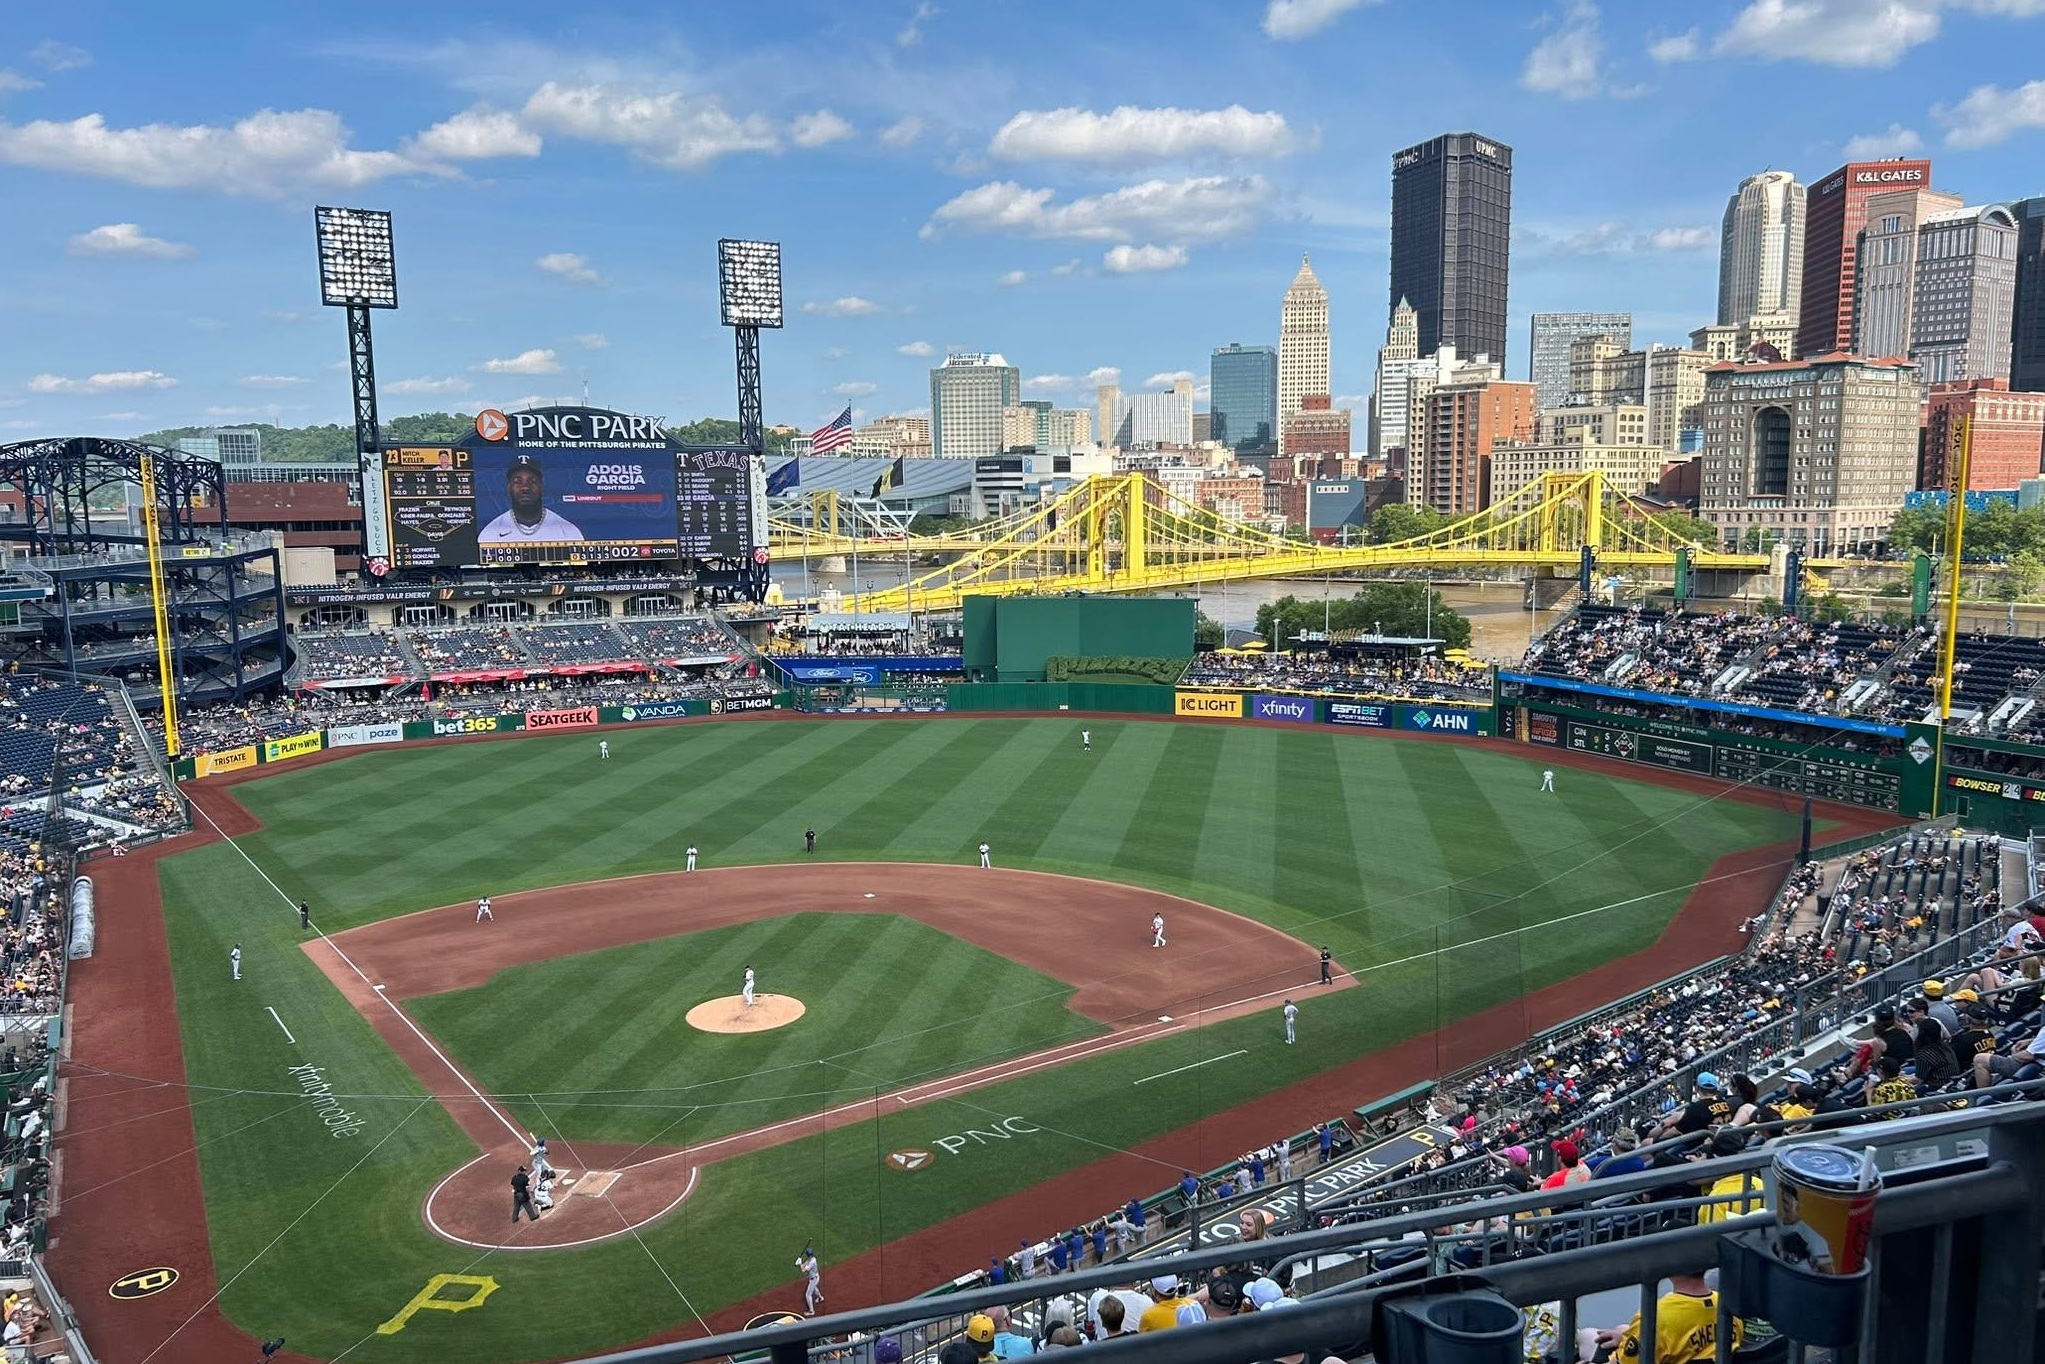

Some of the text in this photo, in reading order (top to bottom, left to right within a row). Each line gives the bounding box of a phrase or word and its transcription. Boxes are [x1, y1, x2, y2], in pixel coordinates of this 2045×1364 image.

[1476, 140, 1497, 158] UPMC
[1856, 169, 1922, 183] K&L GATES
[949, 352, 982, 360] Federated
[513, 413, 666, 440] PNC PARK
[579, 441, 631, 449] PITTSBURGH
[632, 441, 666, 449] PIRATES
[456, 451, 468, 468] P
[676, 450, 749, 471] T TEXAS
[588, 464, 643, 475] ADOLIS
[585, 472, 646, 485] GARCÍA
[573, 584, 631, 593] NITROGEN-INFUSED
[648, 582, 671, 590] ENERGY
[318, 591, 431, 603] NITROGEN-INFUSED VALR ENERGY
[1361, 634, 1384, 644] TIME
[811, 668, 836, 677] Ford
[636, 704, 686, 716] VANDA
[727, 698, 772, 711] BETMGM
[1181, 698, 1237, 712] IC LIGHT
[1261, 700, 1305, 718] xfinity
[1331, 703, 1385, 716] ESPN BET
[530, 710, 594, 728] SEATGEEK
[1336, 713, 1379, 722] SPORTSBOOK
[1432, 713, 1468, 730] AHN
[434, 717, 497, 735] bet365
[1573, 727, 1586, 736] CIN
[1649, 722, 1671, 731] WELCOME
[338, 728, 398, 740] PNC paze
[281, 743, 298, 754] PLAY
[304, 737, 319, 748] WIN!
[1573, 739, 1586, 748] STL
[214, 752, 246, 766] TRISTATE
[1955, 777, 2001, 794] BOWSER
[287, 1063, 366, 1139] xfinity mobile
[932, 1116, 1041, 1155] PNC
[1409, 1132, 1436, 1147] P
[1316, 1156, 1387, 1197] PARK
[376, 1273, 501, 1335] P
[980, 1329, 988, 1339] P
[1690, 1324, 1736, 1347] SKES
